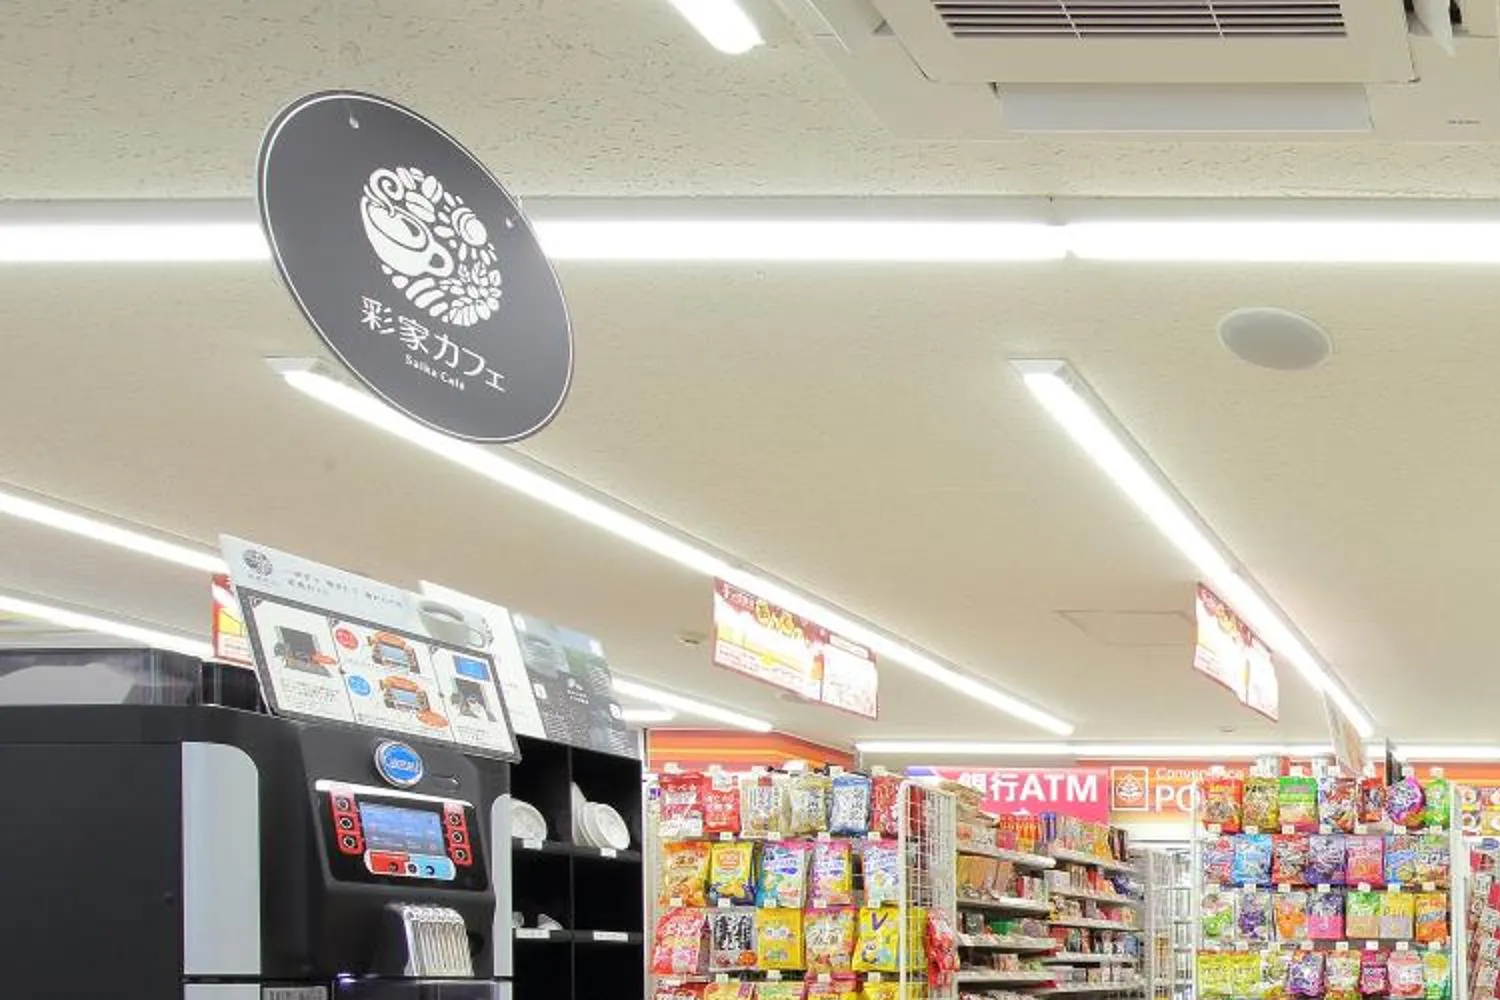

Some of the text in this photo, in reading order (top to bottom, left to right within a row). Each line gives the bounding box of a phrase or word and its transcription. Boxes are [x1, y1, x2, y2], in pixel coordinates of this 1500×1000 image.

[361, 295, 506, 393] 彩家カフェ
